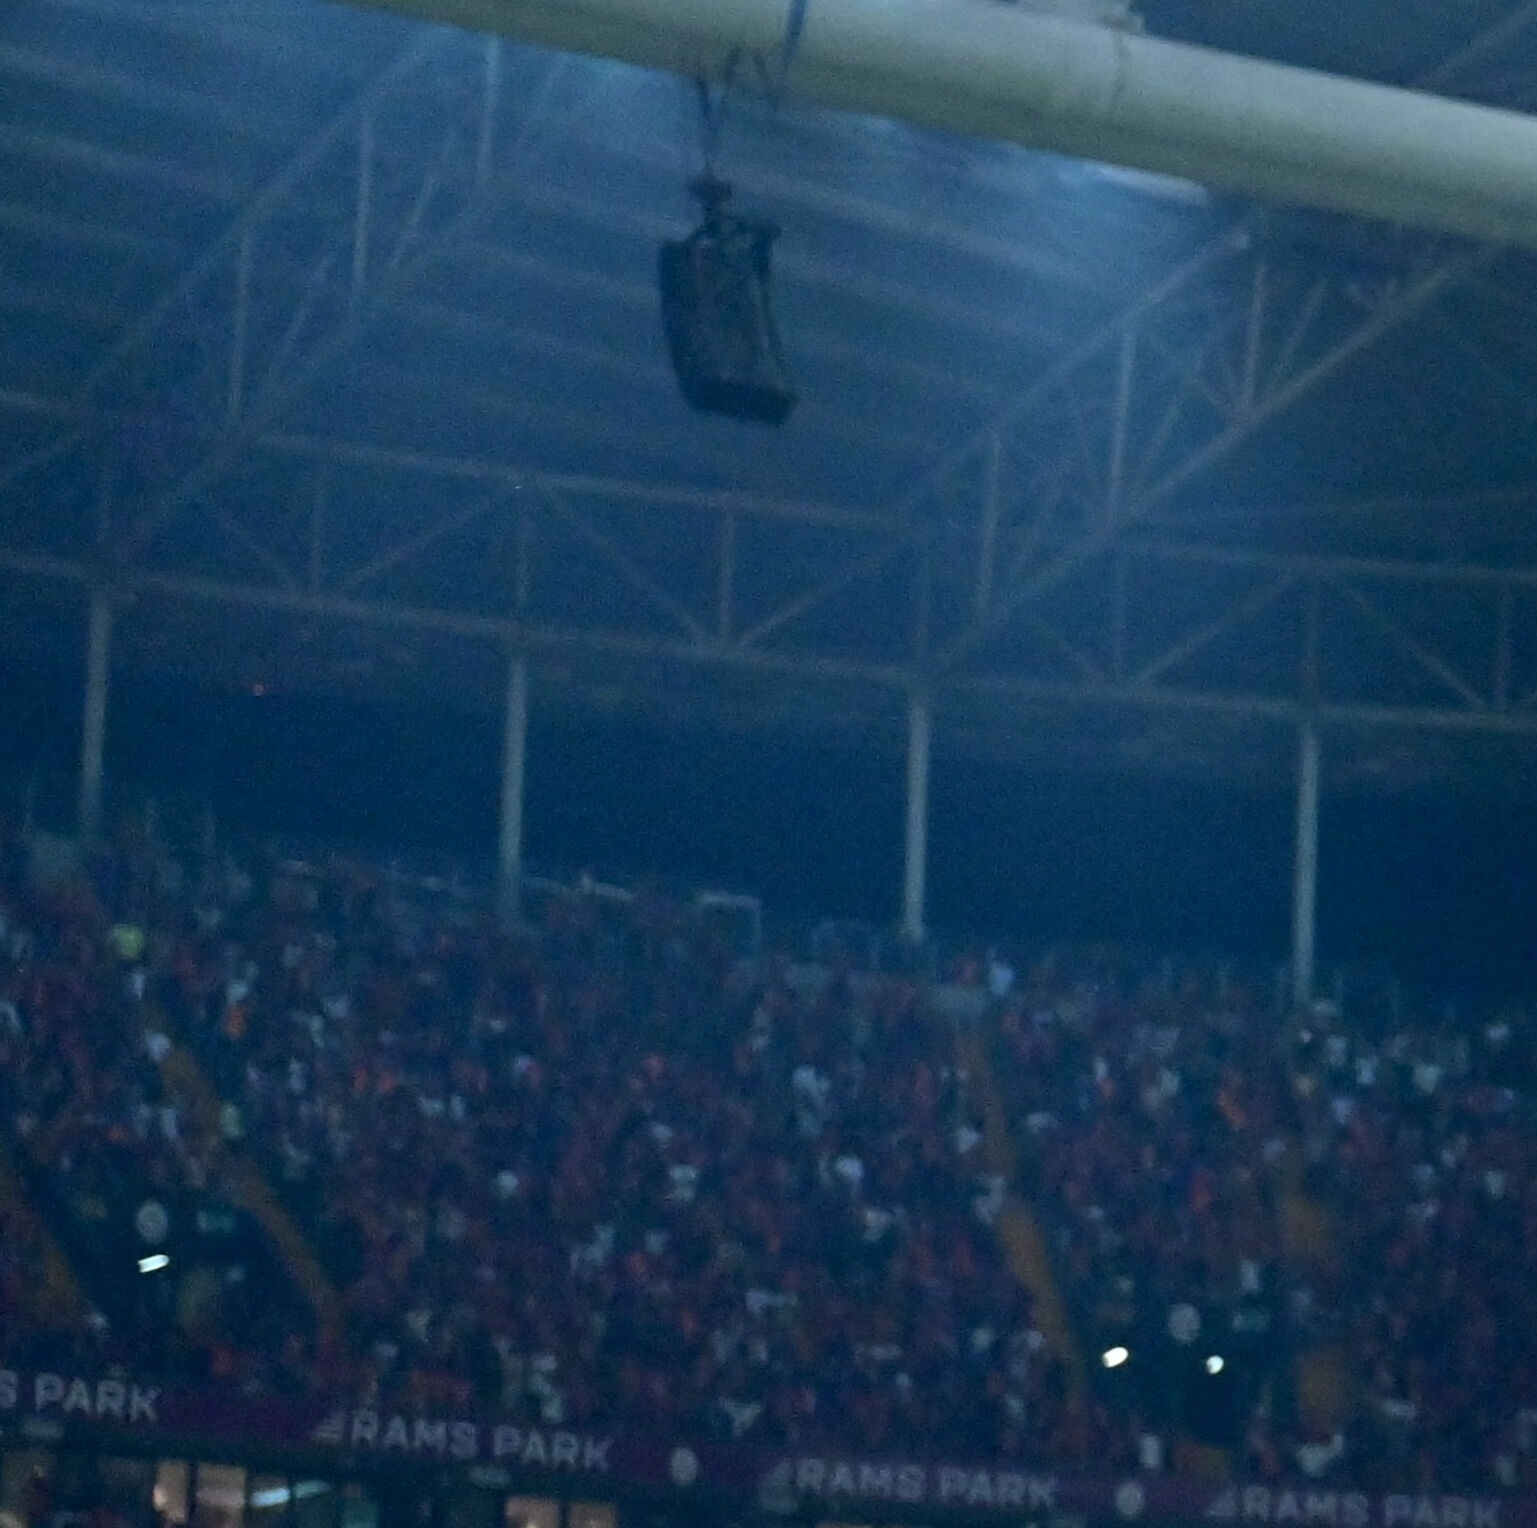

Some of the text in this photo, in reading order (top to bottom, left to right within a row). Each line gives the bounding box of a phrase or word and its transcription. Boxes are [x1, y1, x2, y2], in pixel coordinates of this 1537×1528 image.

[35, 1373, 160, 1421] PARK
[351, 1411, 613, 1471] RAMS PARK
[798, 1459, 1056, 1506] RAMS PARK
[1243, 1488, 1499, 1528] RAMS PARK
